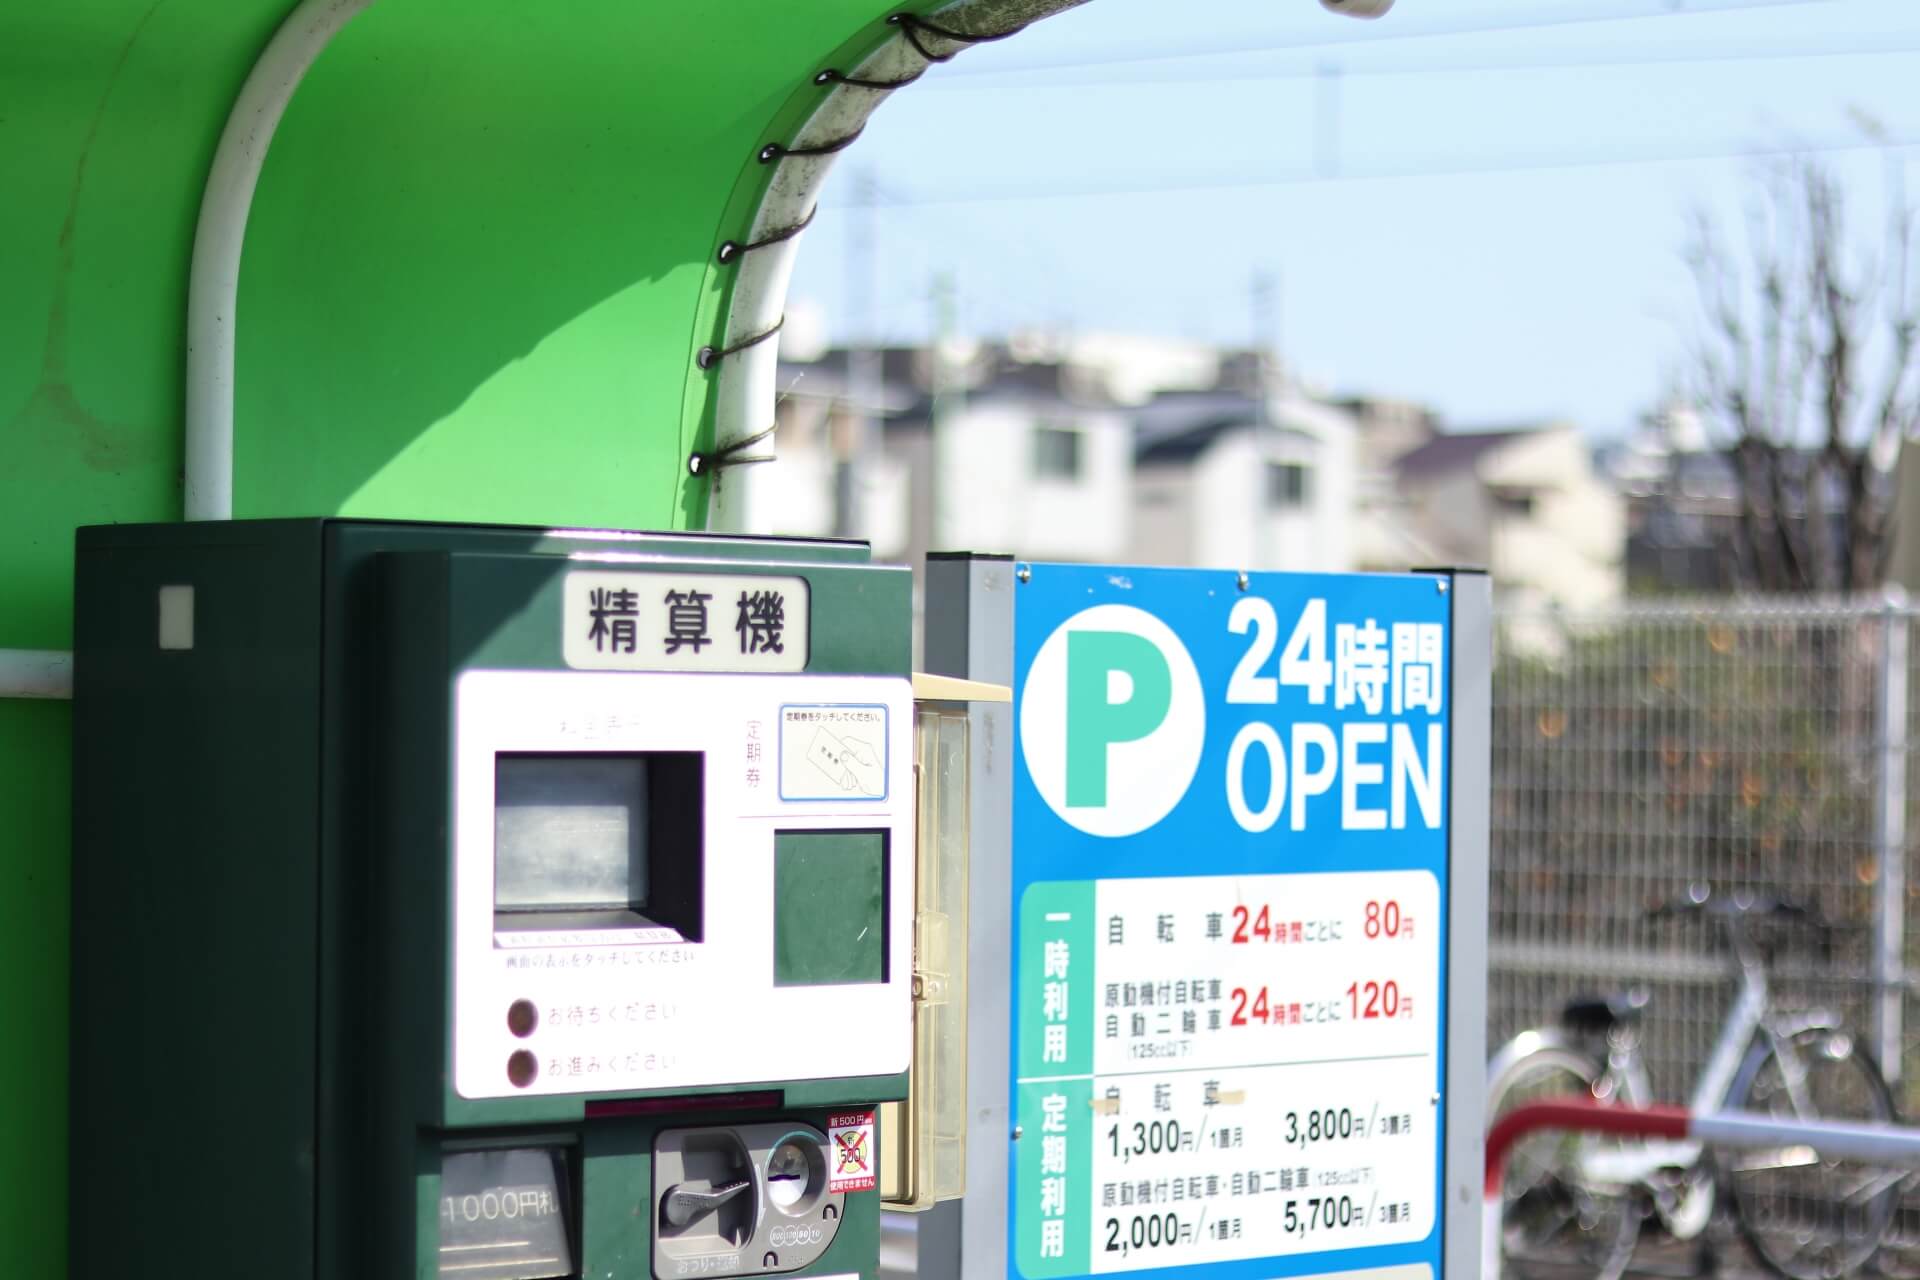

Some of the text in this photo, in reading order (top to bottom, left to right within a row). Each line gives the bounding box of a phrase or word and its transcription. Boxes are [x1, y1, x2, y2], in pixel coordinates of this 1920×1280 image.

[588, 587, 785, 654] 精算機
[1226, 597, 1443, 715] 24時間
[1066, 630, 1172, 808] P
[747, 720, 761, 788] 定期券
[1226, 721, 1442, 832] OPEN
[1108, 912, 1223, 945] 自転車
[1364, 901, 1413, 939] 80円
[1043, 912, 1071, 1063] 一時利用
[1105, 977, 1222, 1008] 原動機付自転車
[1346, 980, 1412, 1019] 120円
[548, 1002, 678, 1027] お待ちください
[1106, 1009, 1222, 1038] 自動二輪車
[548, 1052, 677, 1077] お進みください
[1105, 1080, 1220, 1116] 自転車
[840, 1147, 860, 1163] 500
[1040, 1093, 1067, 1258] 定期利用
[442, 1191, 559, 1222] 1000円札
